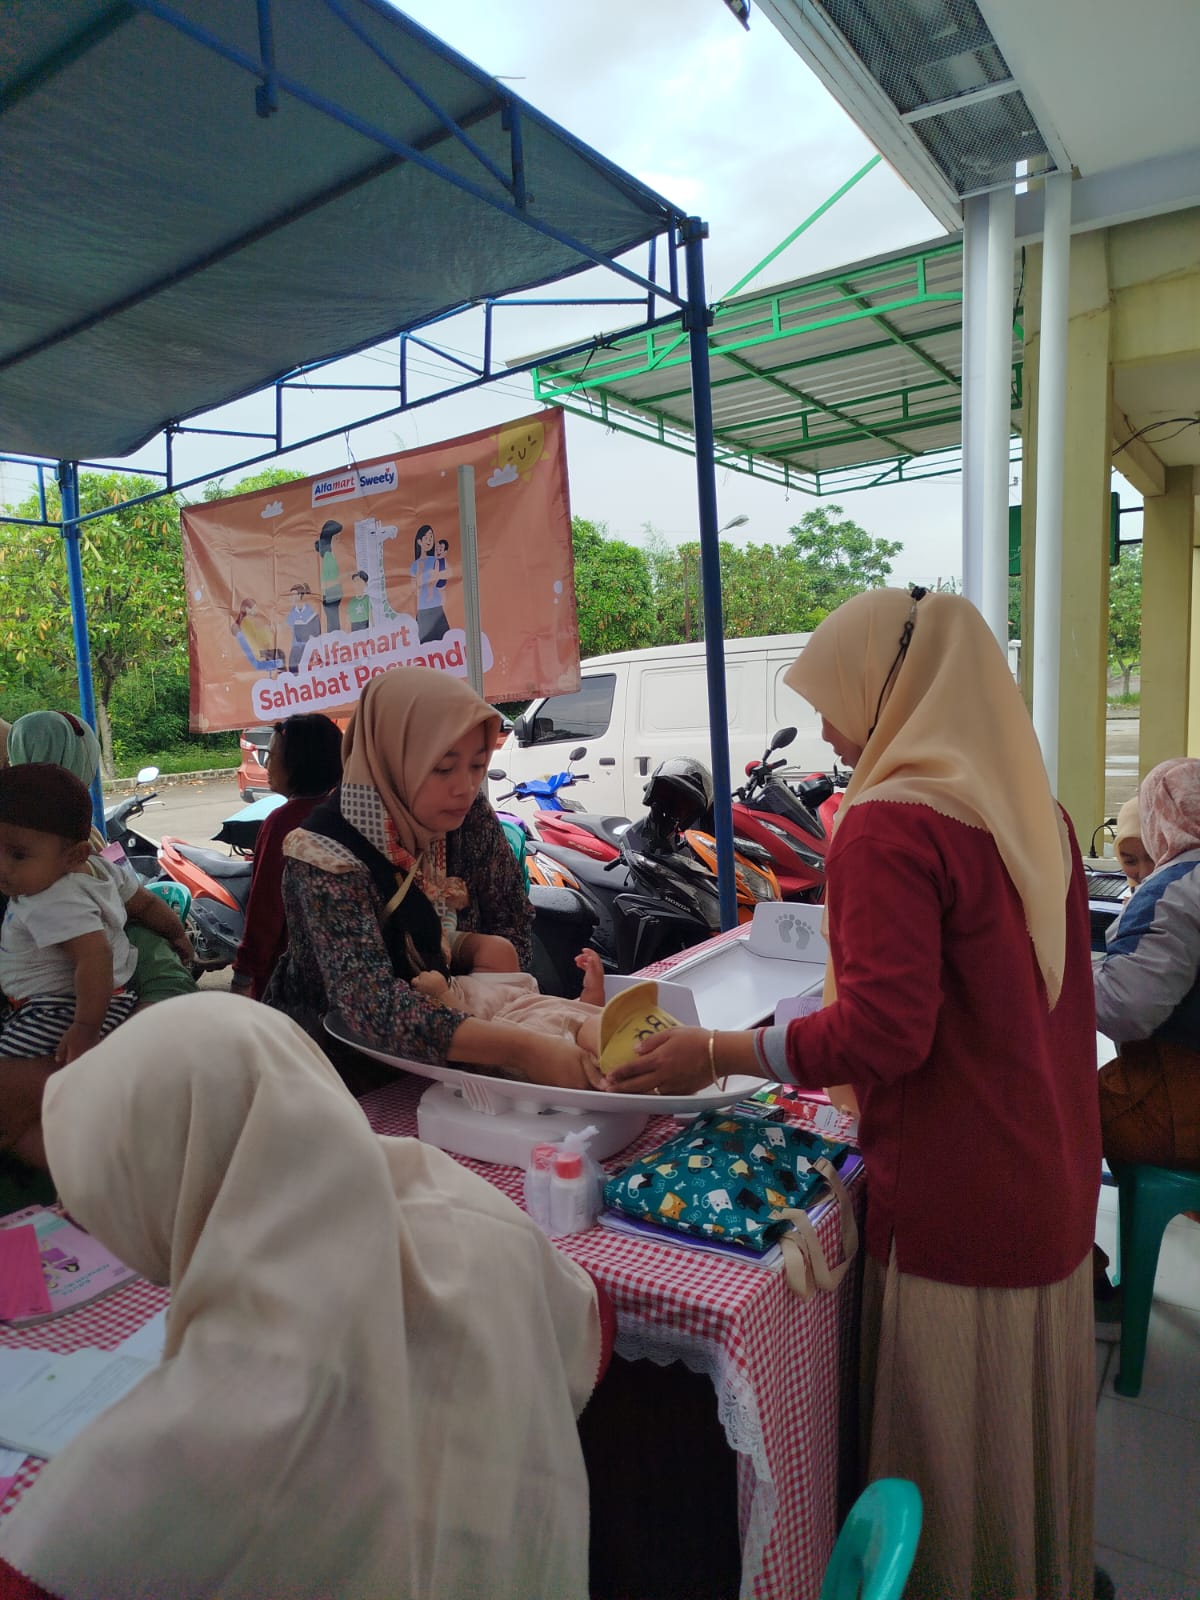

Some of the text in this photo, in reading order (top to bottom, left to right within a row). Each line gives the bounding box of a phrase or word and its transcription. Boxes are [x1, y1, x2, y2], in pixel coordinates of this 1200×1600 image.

[315, 470, 395, 495] Alfamart Sweety
[307, 625, 411, 672] Alfamart
[259, 671, 351, 711] Sahabat
[665, 896, 691, 912] HONDA
